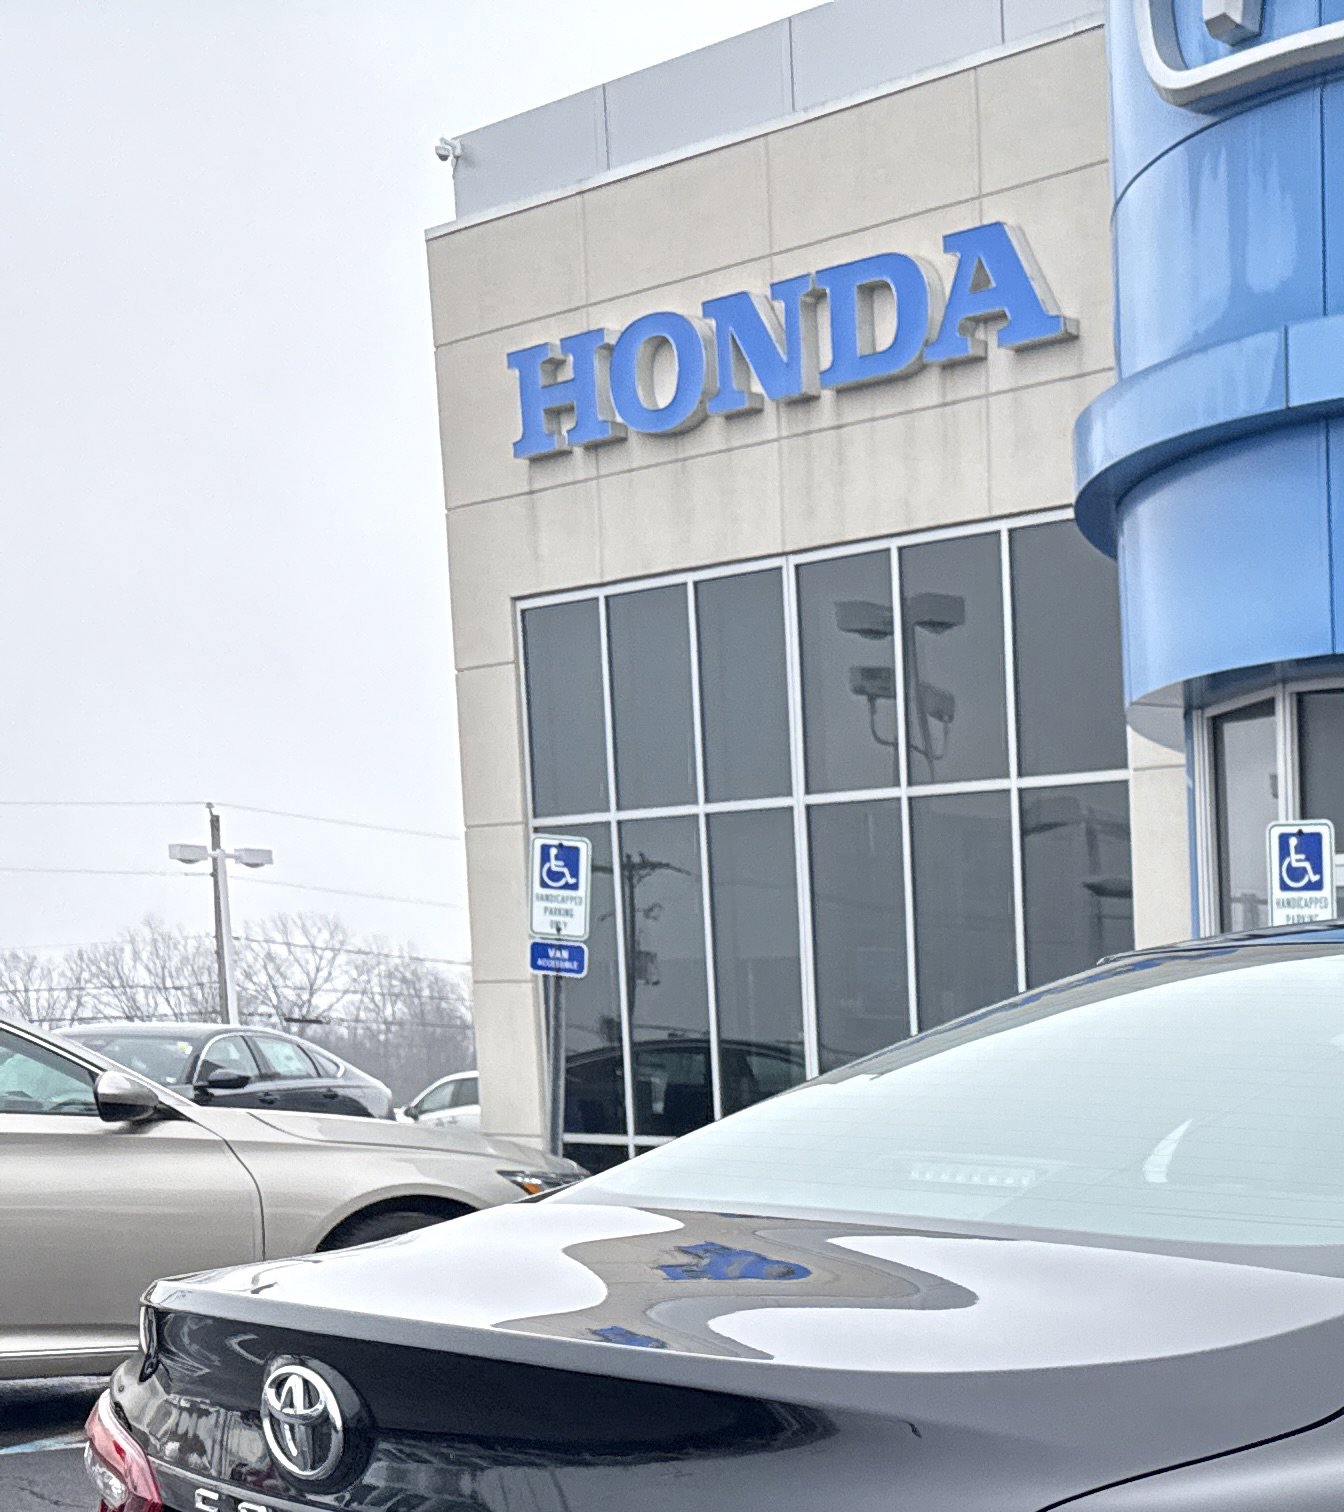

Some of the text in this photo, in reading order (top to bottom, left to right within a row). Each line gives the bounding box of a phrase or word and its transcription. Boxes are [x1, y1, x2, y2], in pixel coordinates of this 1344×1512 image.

[507, 221, 1078, 460] HONDA
[535, 891, 583, 906] HANDICAPPED
[1275, 896, 1329, 909] HANDICAPPED
[544, 906, 574, 918] PARKING
[547, 946, 570, 960] VAN
[536, 957, 579, 970] ACCESSIBLE
